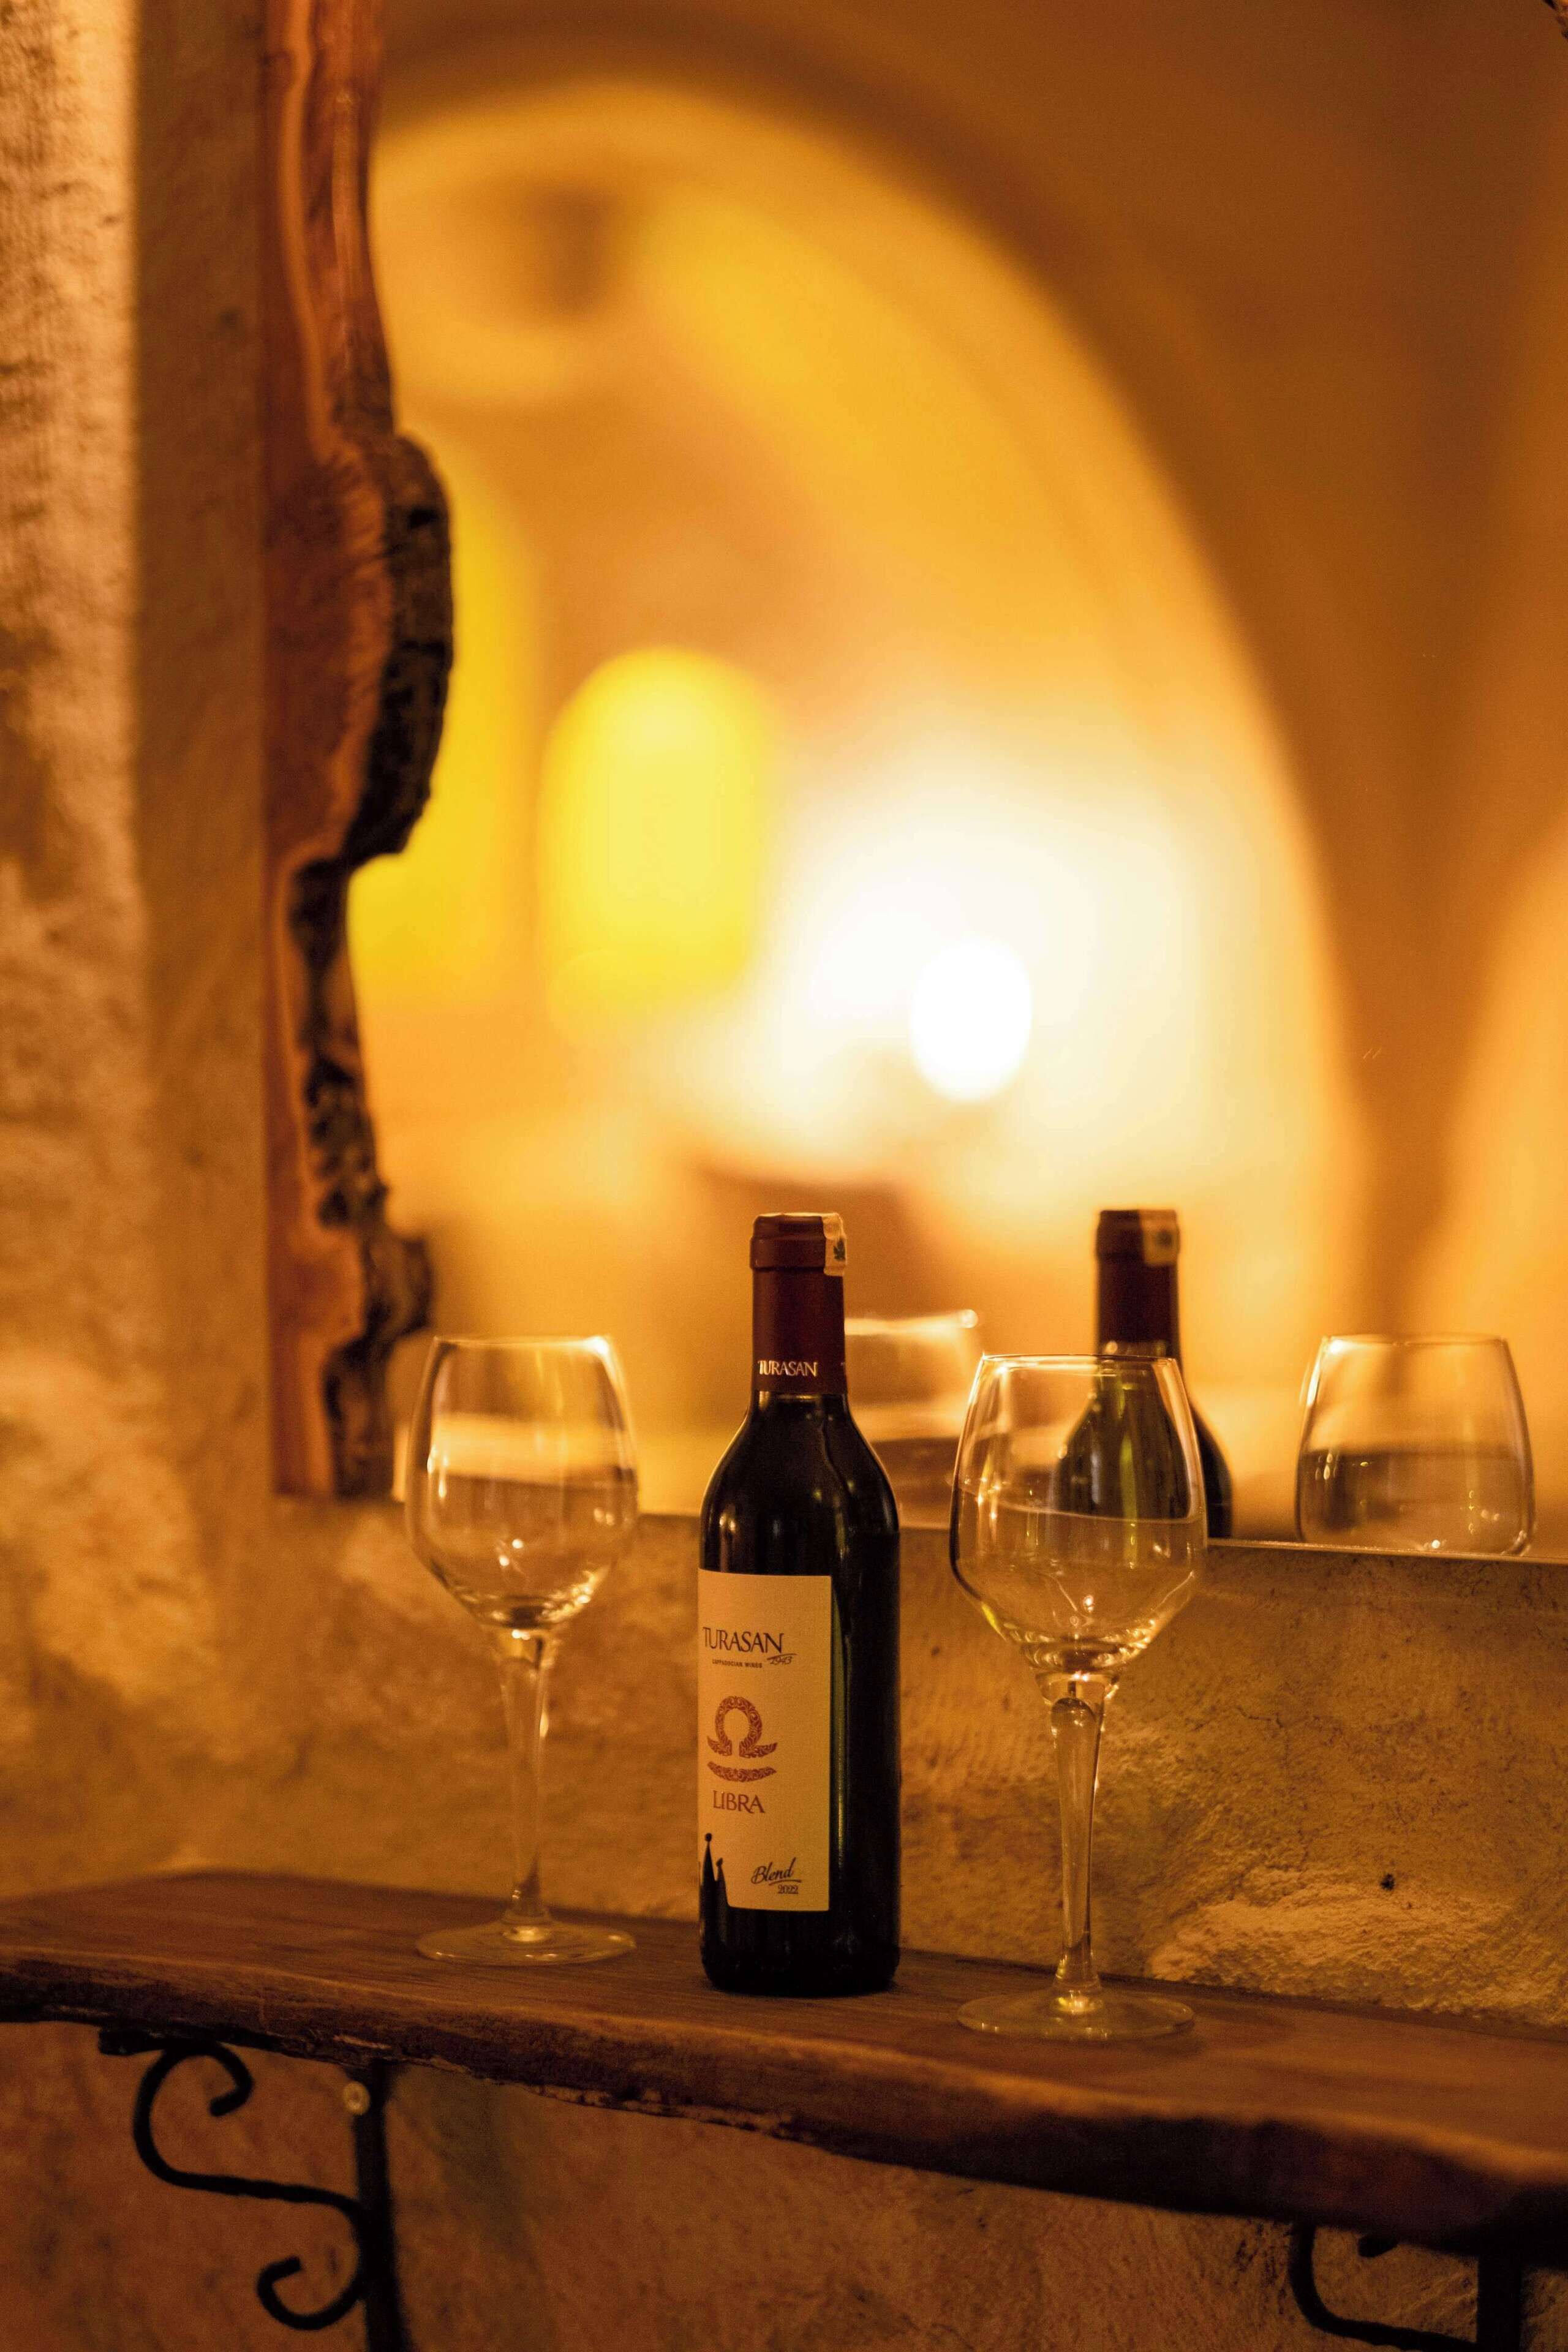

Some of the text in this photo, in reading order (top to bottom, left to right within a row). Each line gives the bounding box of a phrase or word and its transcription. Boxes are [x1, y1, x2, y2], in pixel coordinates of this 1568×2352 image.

[758, 1360, 818, 1377] TURASAN
[703, 1626, 785, 1654] TURASAN
[769, 1656, 793, 1666] 1943
[712, 1790, 766, 1814] LIBRA
[751, 1856, 796, 1884] Blend
[777, 1884, 799, 1894] 2022
